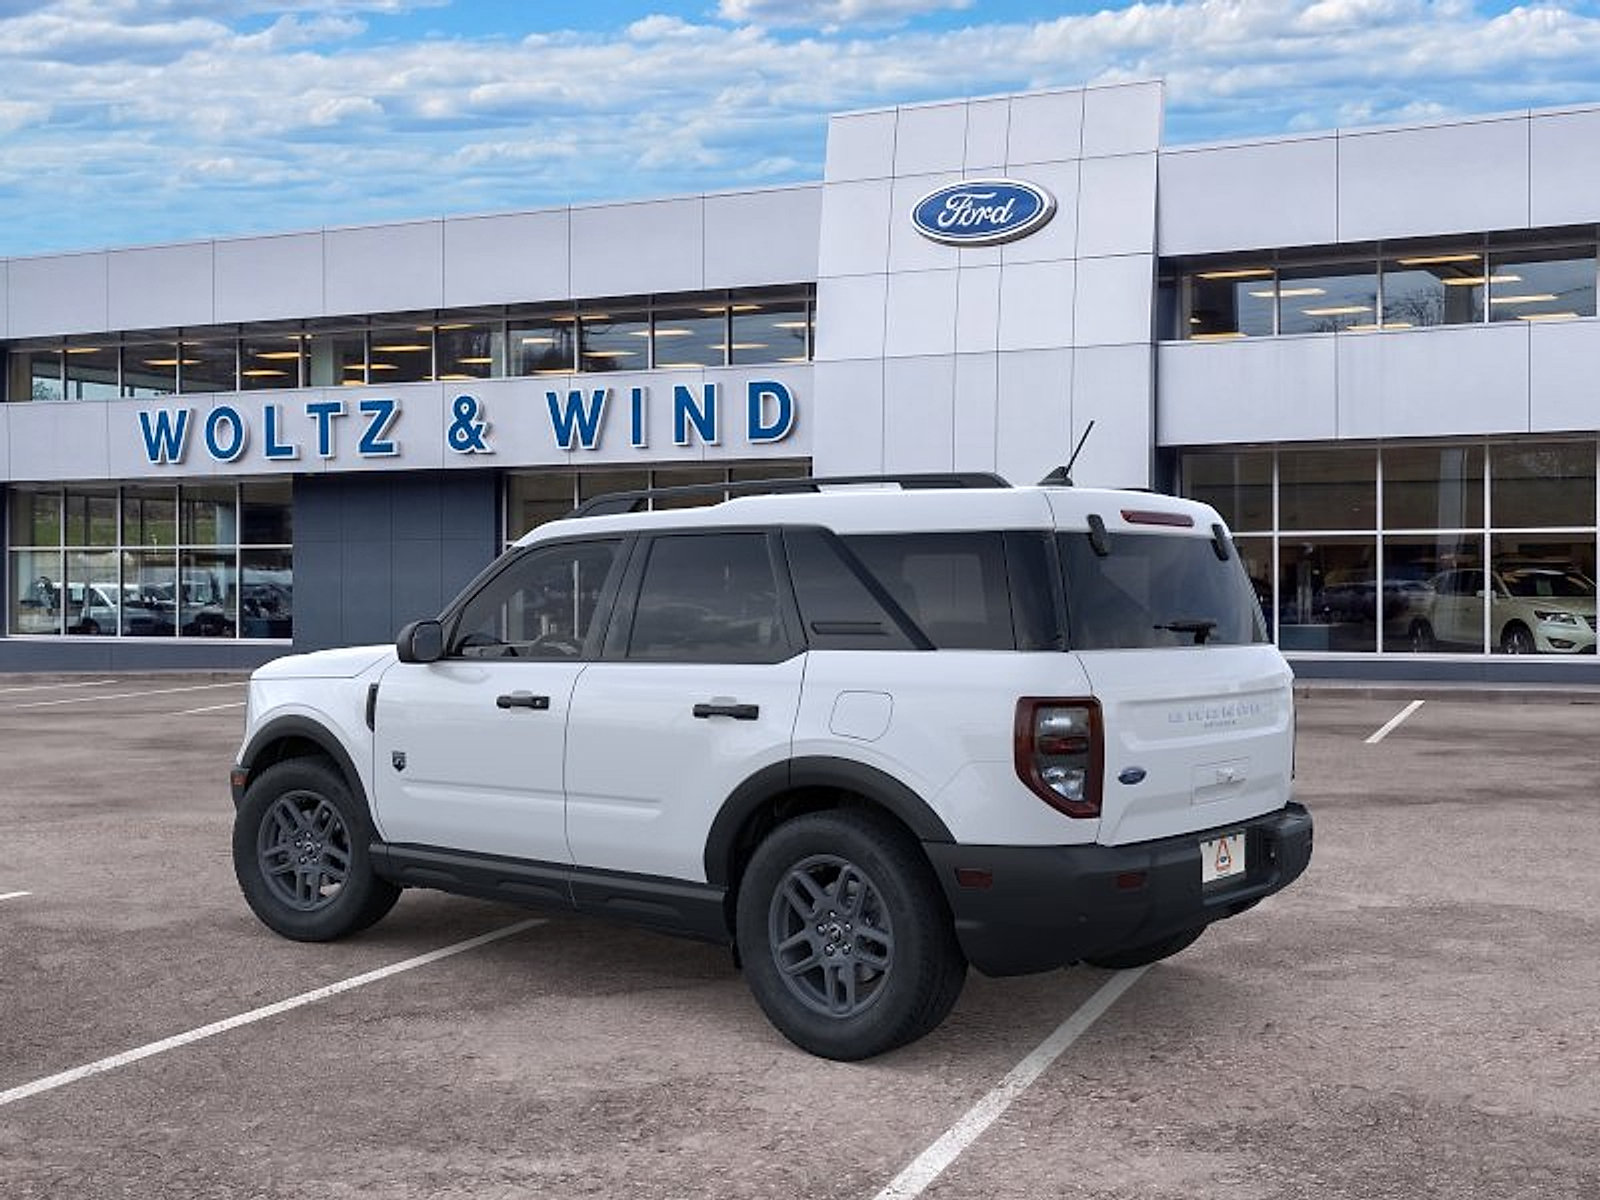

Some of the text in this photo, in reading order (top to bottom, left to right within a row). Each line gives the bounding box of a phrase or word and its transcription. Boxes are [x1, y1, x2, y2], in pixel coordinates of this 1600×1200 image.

[937, 191, 1016, 228] Ford
[138, 380, 795, 464] WOLTZ & WIND
